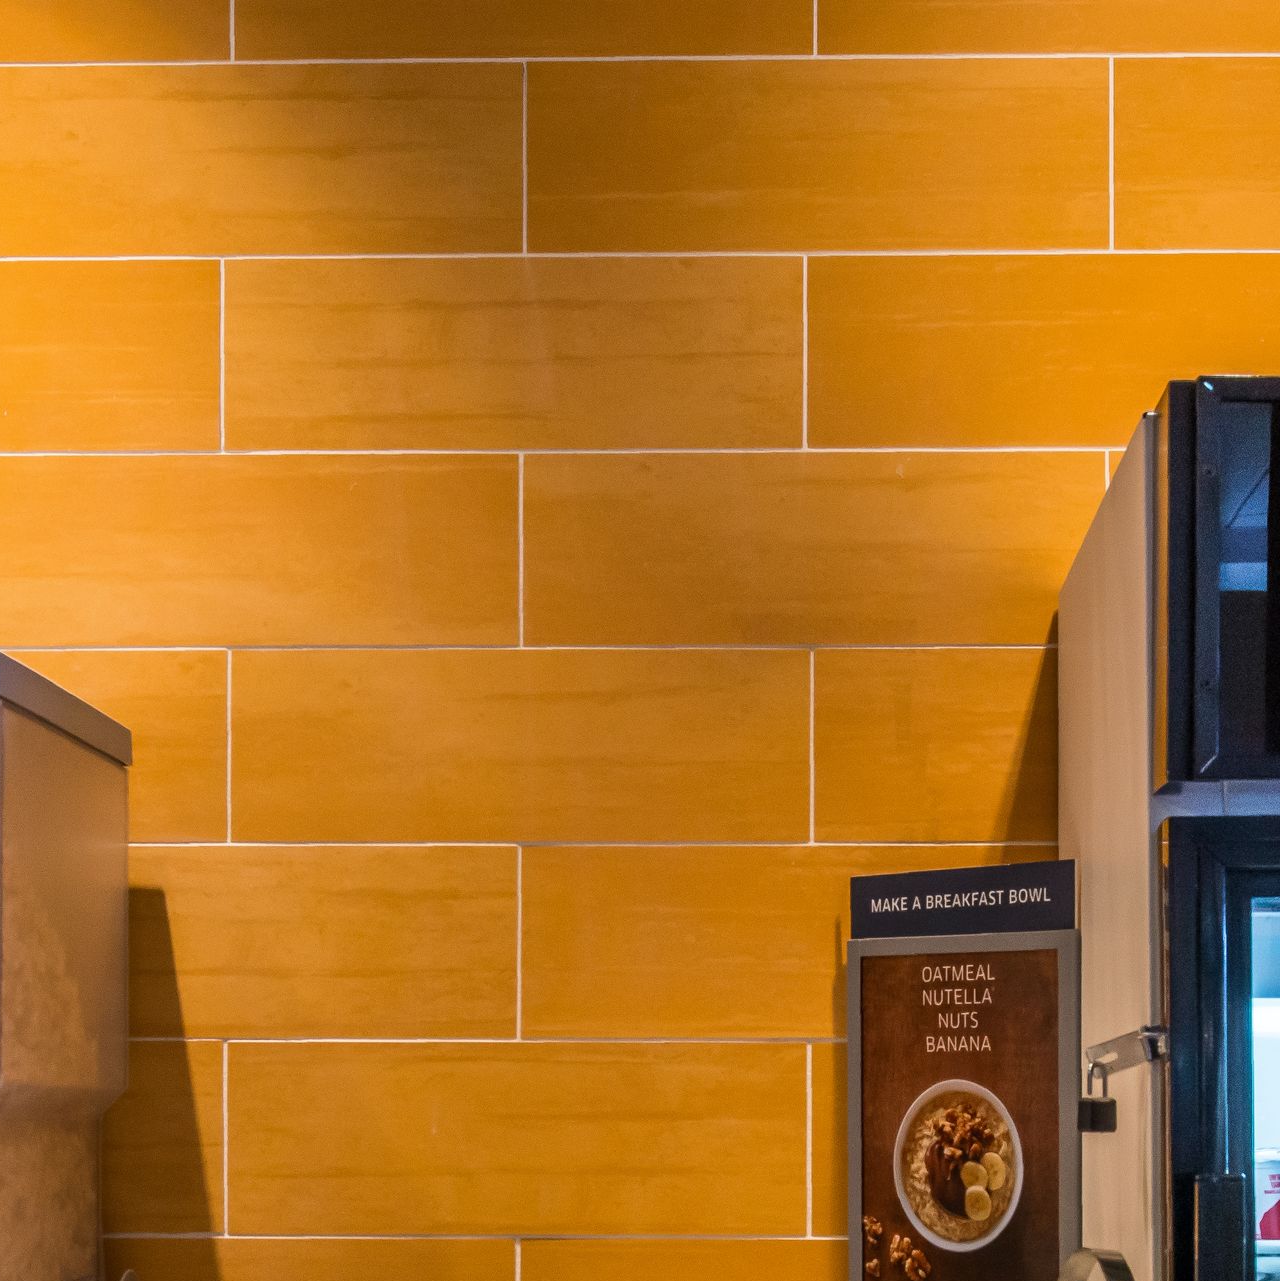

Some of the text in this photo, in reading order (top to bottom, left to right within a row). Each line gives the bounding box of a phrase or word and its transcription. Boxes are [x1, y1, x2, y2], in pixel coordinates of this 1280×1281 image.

[870, 887, 1051, 913] MAKE A BREAKFAST BOWL
[921, 963, 996, 983] OATMEAL
[922, 987, 993, 1006] NUTELLA
[937, 1011, 979, 1029] NUTS
[925, 1035, 992, 1053] BANANA
